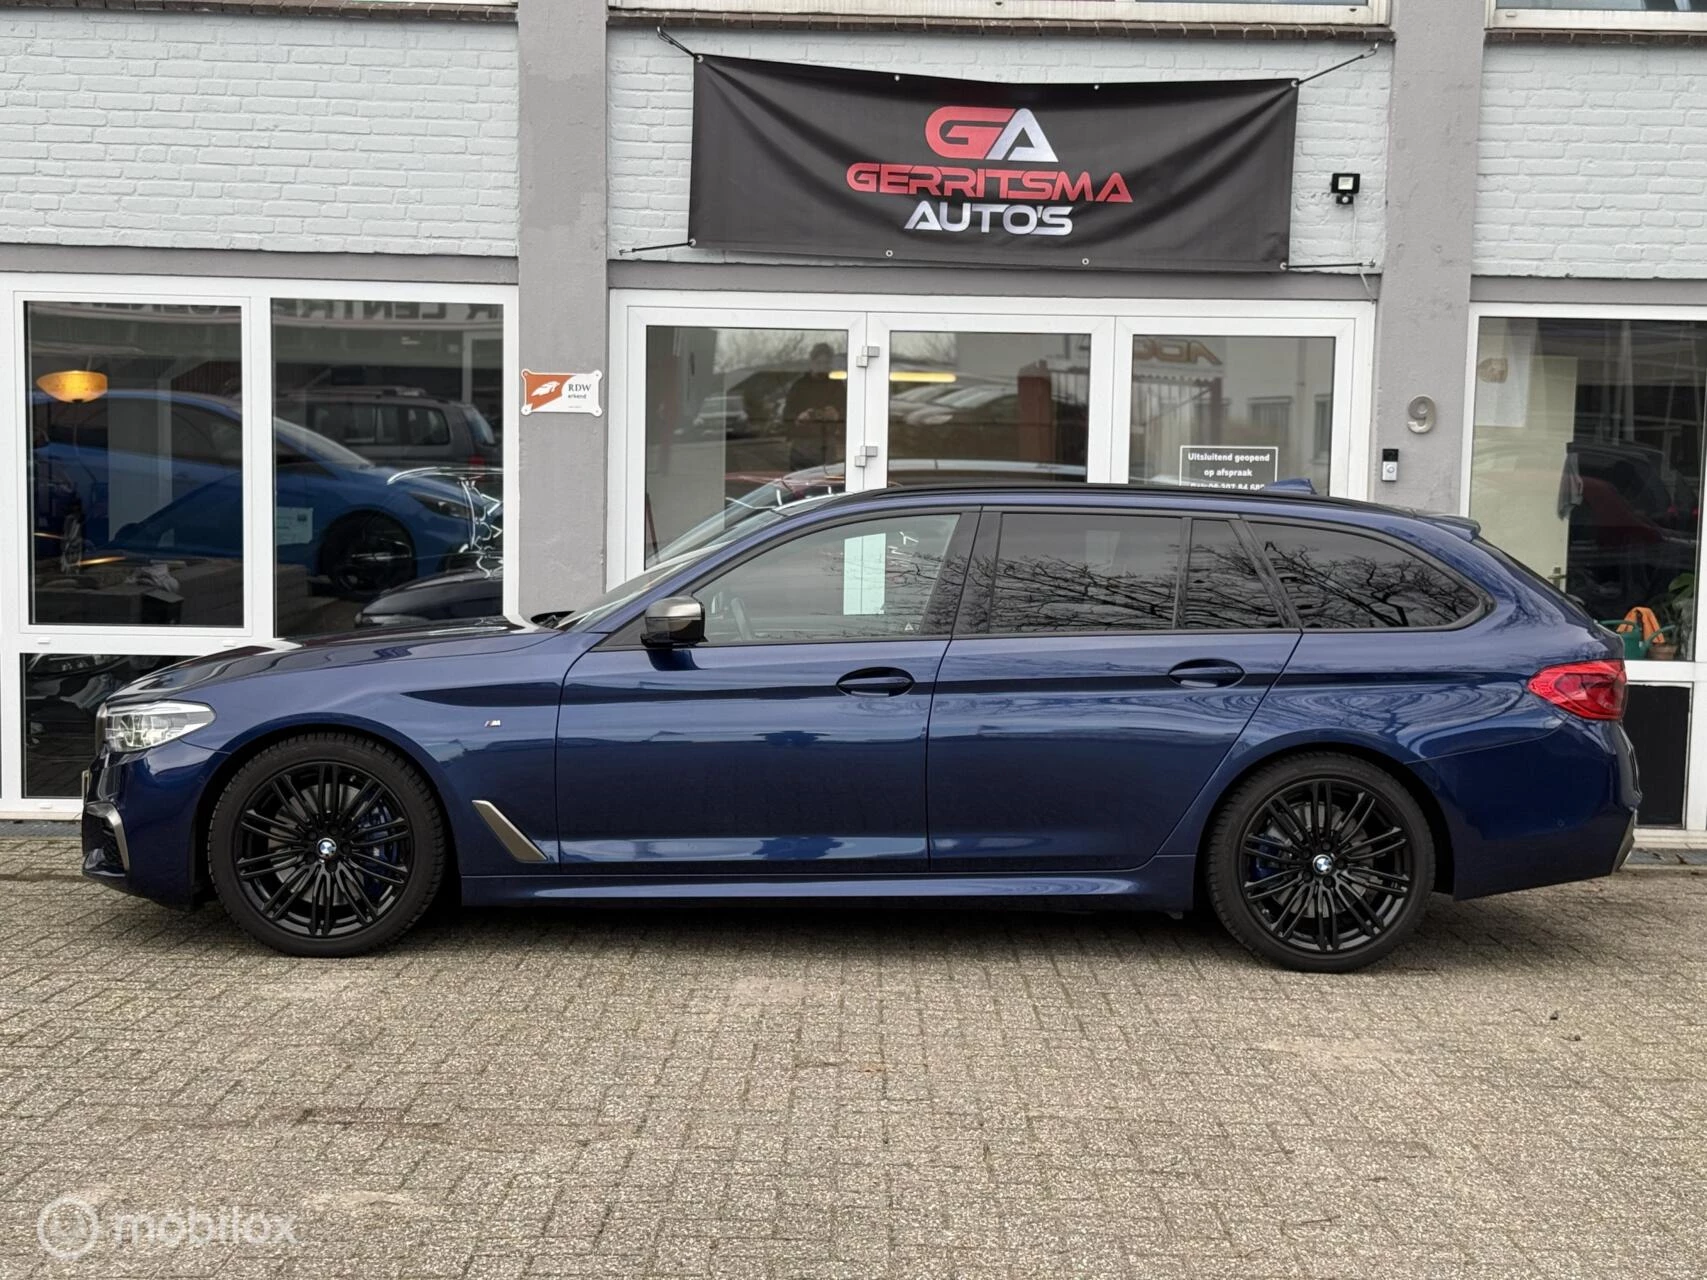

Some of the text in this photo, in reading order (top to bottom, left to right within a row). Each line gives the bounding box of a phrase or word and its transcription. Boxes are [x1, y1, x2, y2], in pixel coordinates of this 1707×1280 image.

[925, 105, 1059, 163] GA
[846, 162, 1133, 203] GERRITSMA
[904, 200, 1074, 236] AUTO'S
[568, 383, 592, 392] RDW
[1408, 394, 1436, 434] 9
[1188, 452, 1270, 463] Uitsluitend geopend
[1204, 468, 1253, 478] op afspraak
